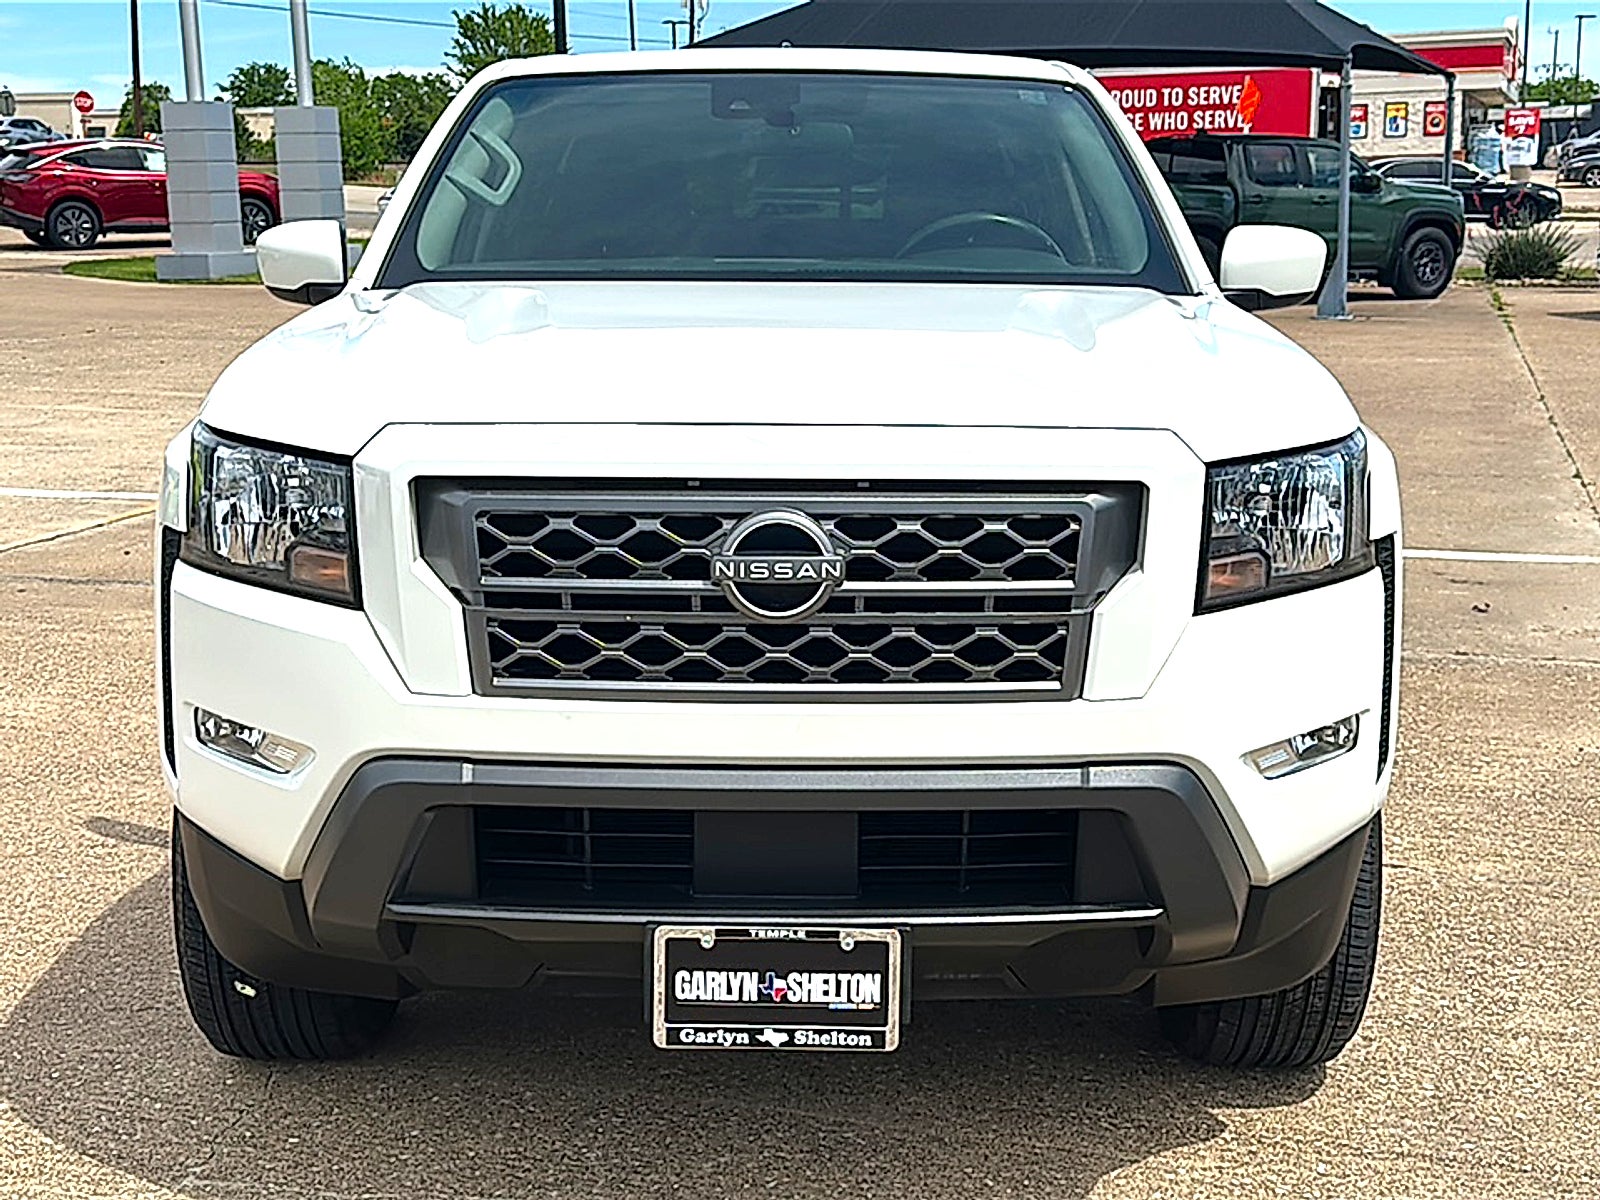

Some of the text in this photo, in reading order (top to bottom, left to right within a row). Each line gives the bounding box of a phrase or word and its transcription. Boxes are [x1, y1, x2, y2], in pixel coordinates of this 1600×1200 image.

[1161, 87, 1183, 107] TO
[1187, 84, 1242, 106] SERVE
[1148, 110, 1188, 131] WHO
[715, 561, 840, 579] NISSAN
[749, 929, 806, 940] TEMPLE
[675, 970, 881, 1003] GARLYN SHELTON
[679, 1028, 872, 1047] Garlyn Shelton
